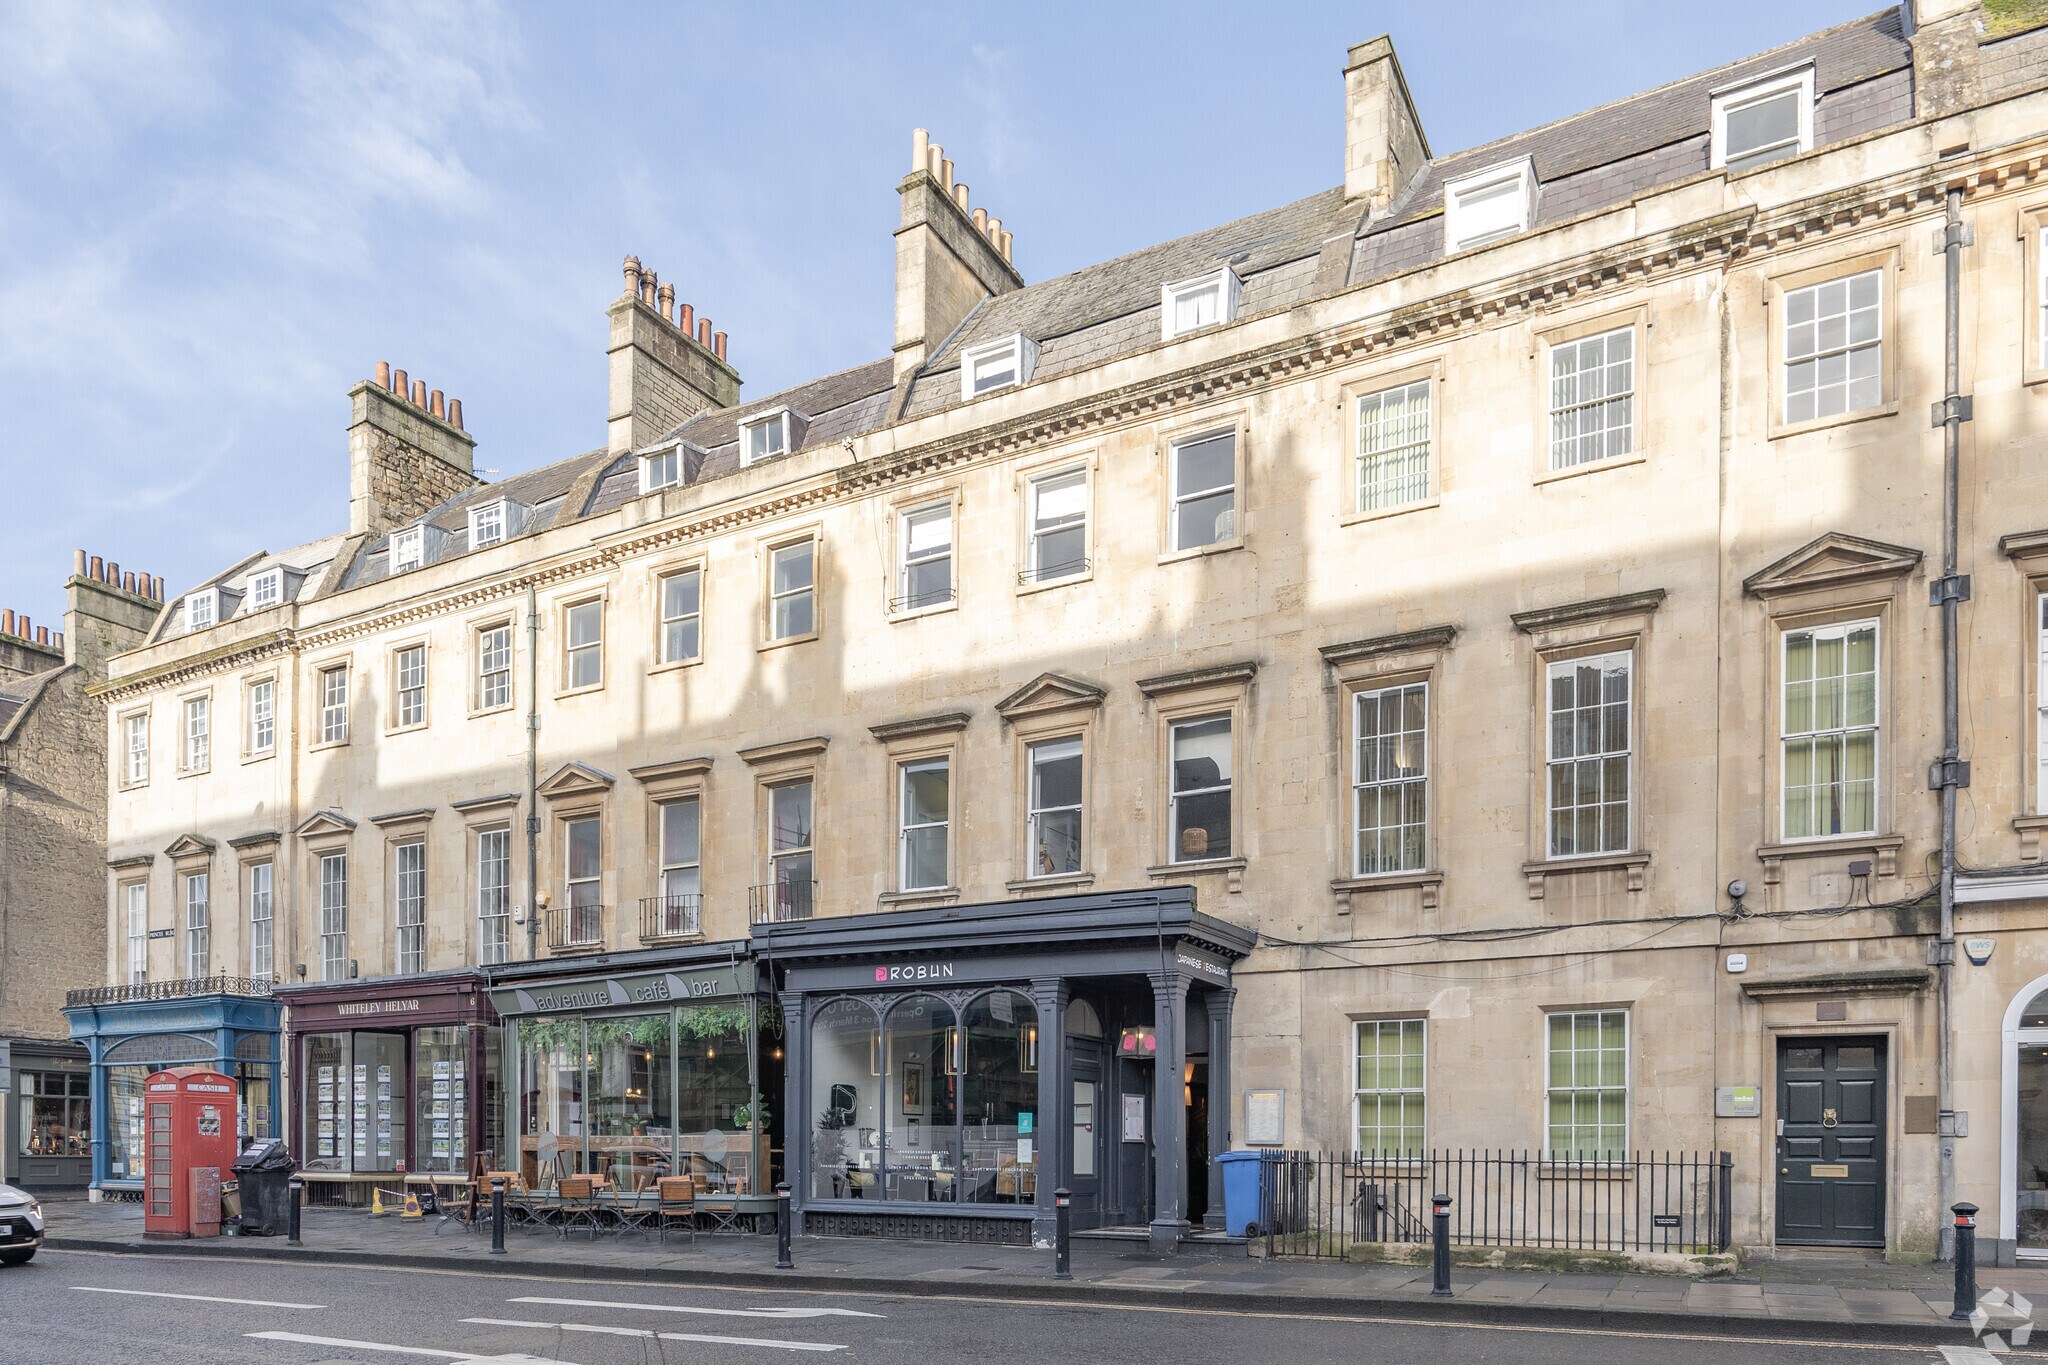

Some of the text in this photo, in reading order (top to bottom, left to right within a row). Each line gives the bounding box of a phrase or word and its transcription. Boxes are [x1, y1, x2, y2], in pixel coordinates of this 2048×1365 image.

[1970, 941, 1991, 949] BWS
[890, 962, 953, 980] ROBUN
[1177, 953, 1228, 978] JAPANESE RESTAURANT
[469, 997, 476, 1006] 6
[537, 977, 718, 1011] adventure café bar
[337, 999, 420, 1015] WHITELEY HELYAR
